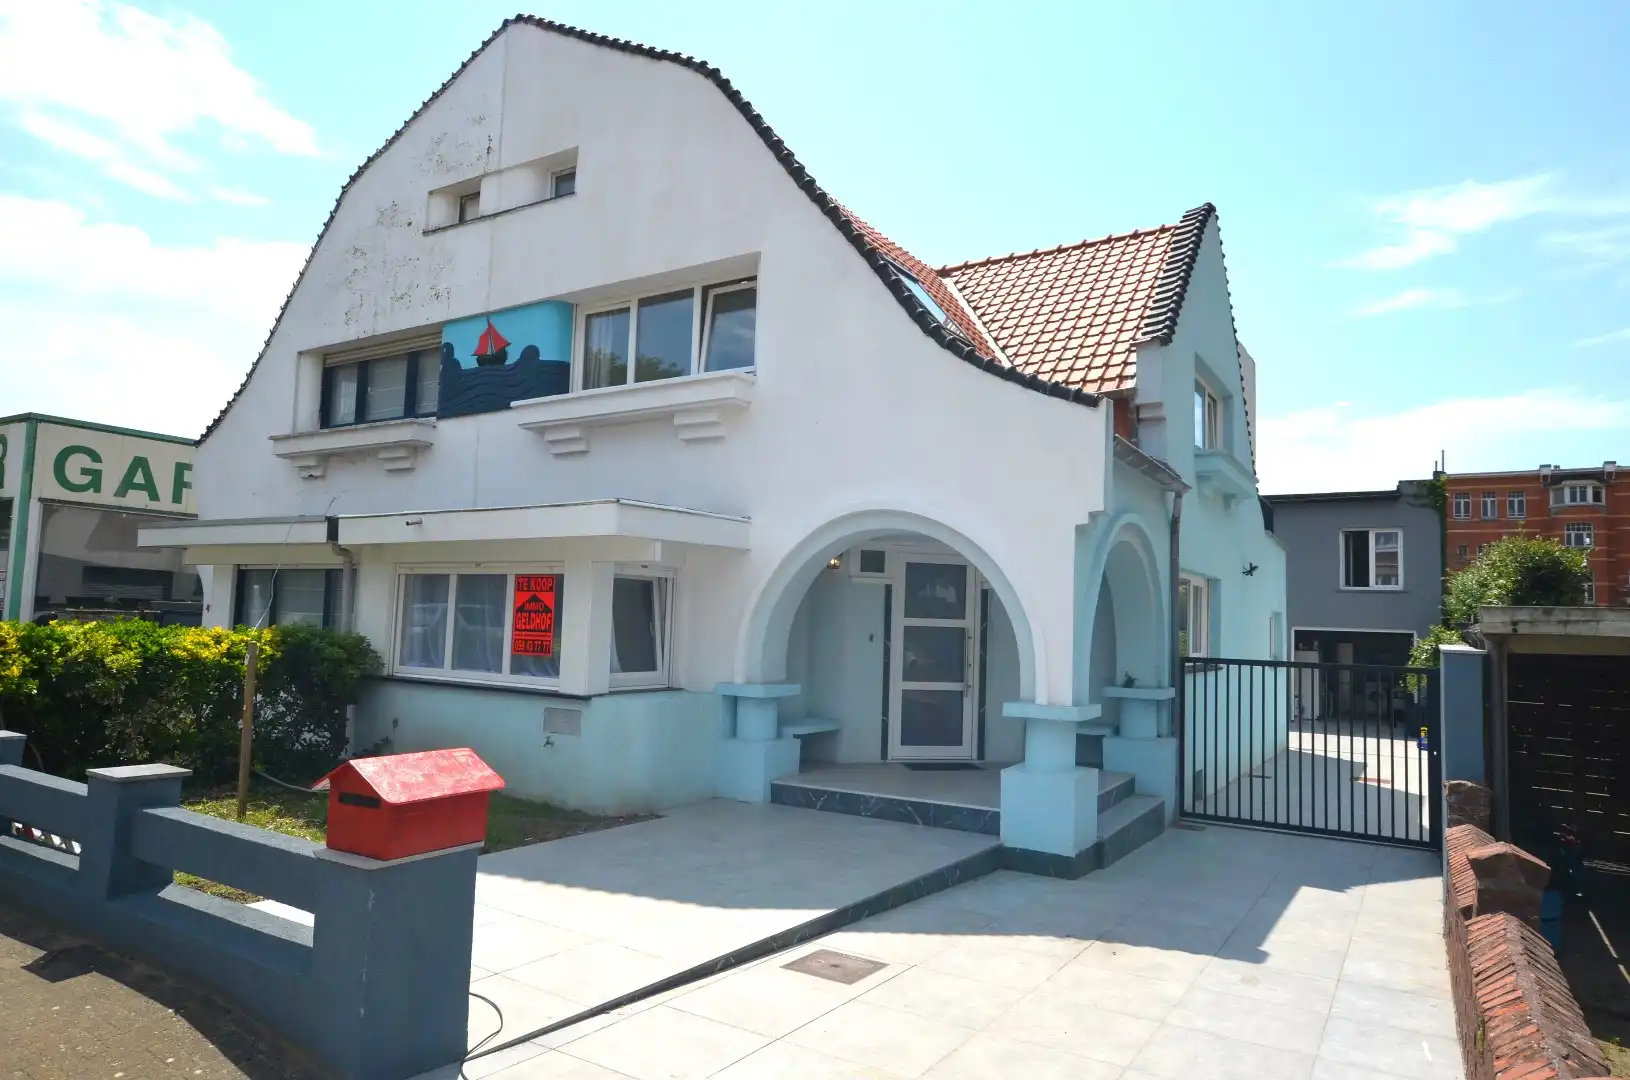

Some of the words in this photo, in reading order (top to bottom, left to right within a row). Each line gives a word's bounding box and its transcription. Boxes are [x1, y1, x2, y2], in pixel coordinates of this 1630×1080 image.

[518, 578, 528, 590] TE
[530, 578, 553, 591] KOOP
[516, 612, 552, 630] GELDHOF
